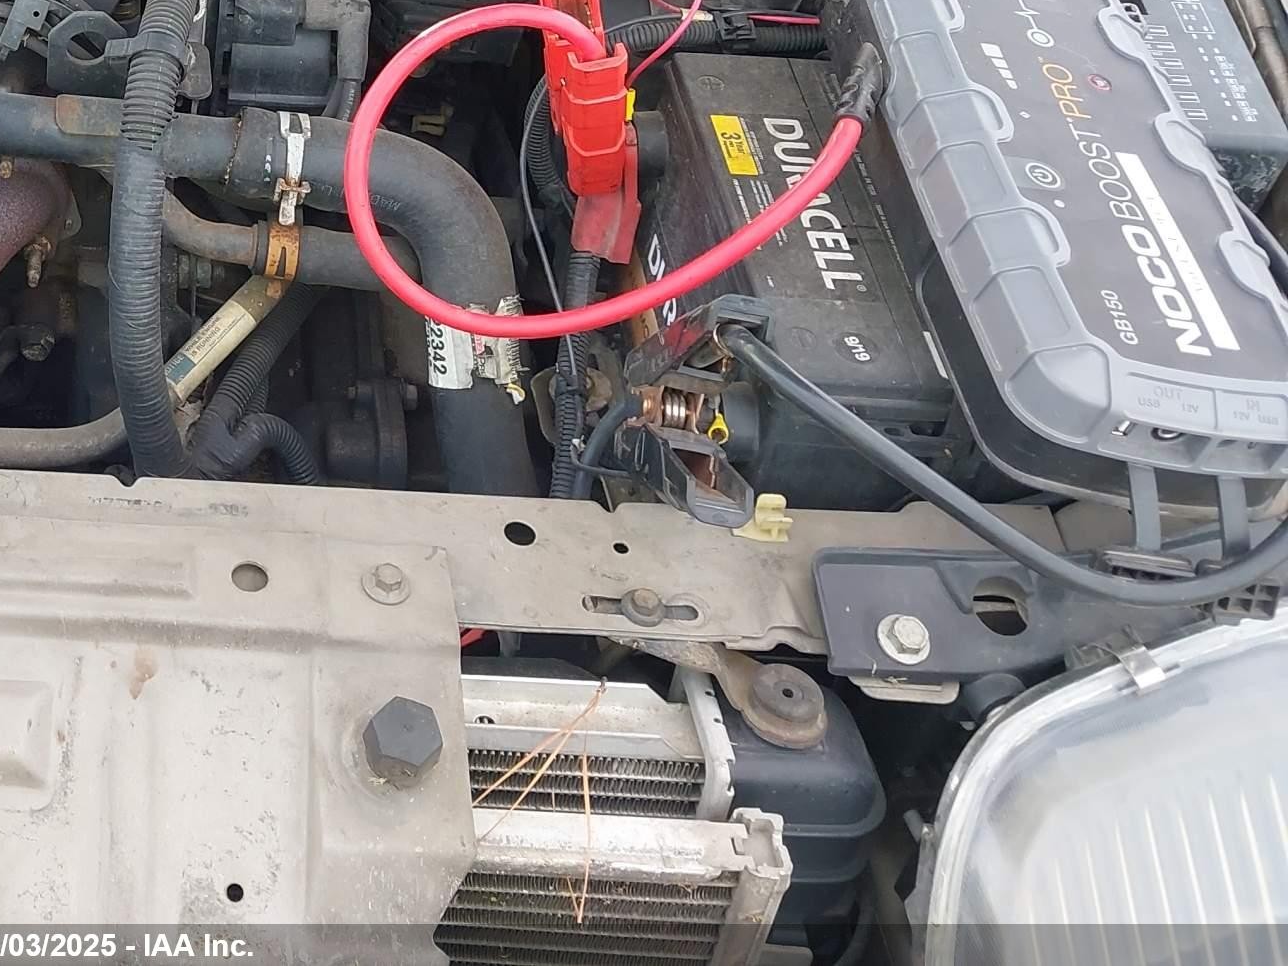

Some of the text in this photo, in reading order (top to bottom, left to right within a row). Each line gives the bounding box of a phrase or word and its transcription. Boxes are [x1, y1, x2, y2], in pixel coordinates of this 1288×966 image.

[1042, 63, 1092, 120] PRO
[1069, 121, 1145, 221] BOOST
[1101, 289, 1138, 345] GB150
[1121, 224, 1212, 357] NOCO
[430, 318, 448, 376] 2342
[1137, 396, 1200, 414] USB 12V
[1153, 386, 1184, 401] OUT
